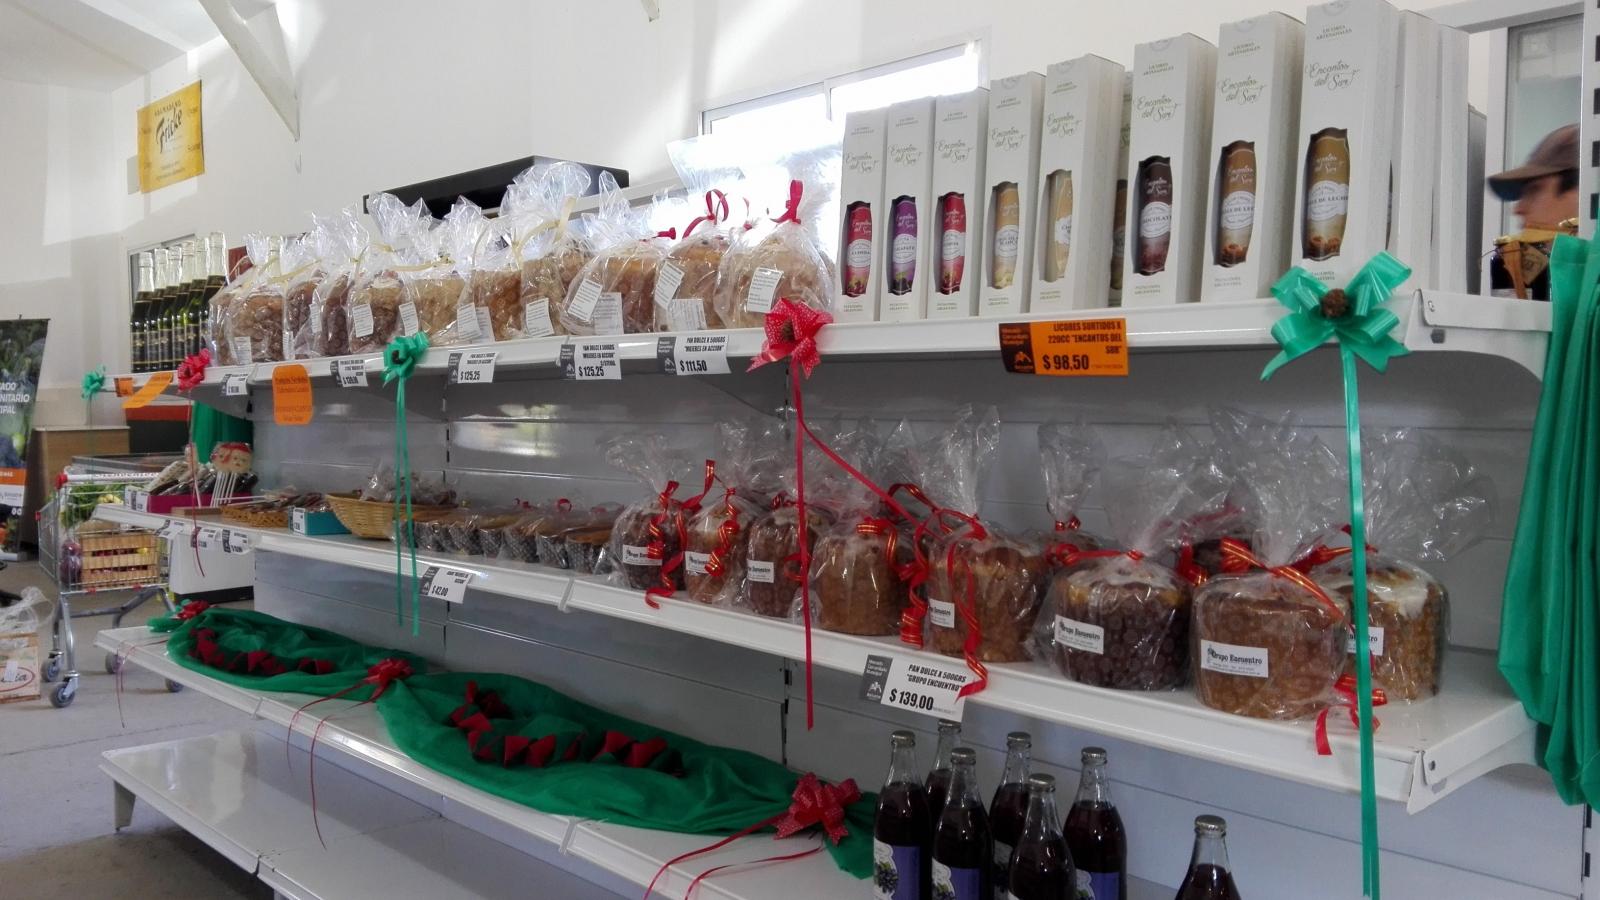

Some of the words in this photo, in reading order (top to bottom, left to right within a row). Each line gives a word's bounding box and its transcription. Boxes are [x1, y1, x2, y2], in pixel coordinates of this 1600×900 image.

[680, 360, 685, 372] $
[1042, 354, 1051, 370] $
[1053, 354, 1090, 370] 98,50
[579, 366, 583, 377] $
[1211, 651, 1228, 662] Grupo
[1229, 654, 1262, 664] Encuentro
[908, 664, 920, 672] PAN
[920, 666, 938, 676] DULCE
[942, 671, 966, 683] 500GRS
[889, 688, 897, 703] $
[899, 690, 934, 711] 139,00
